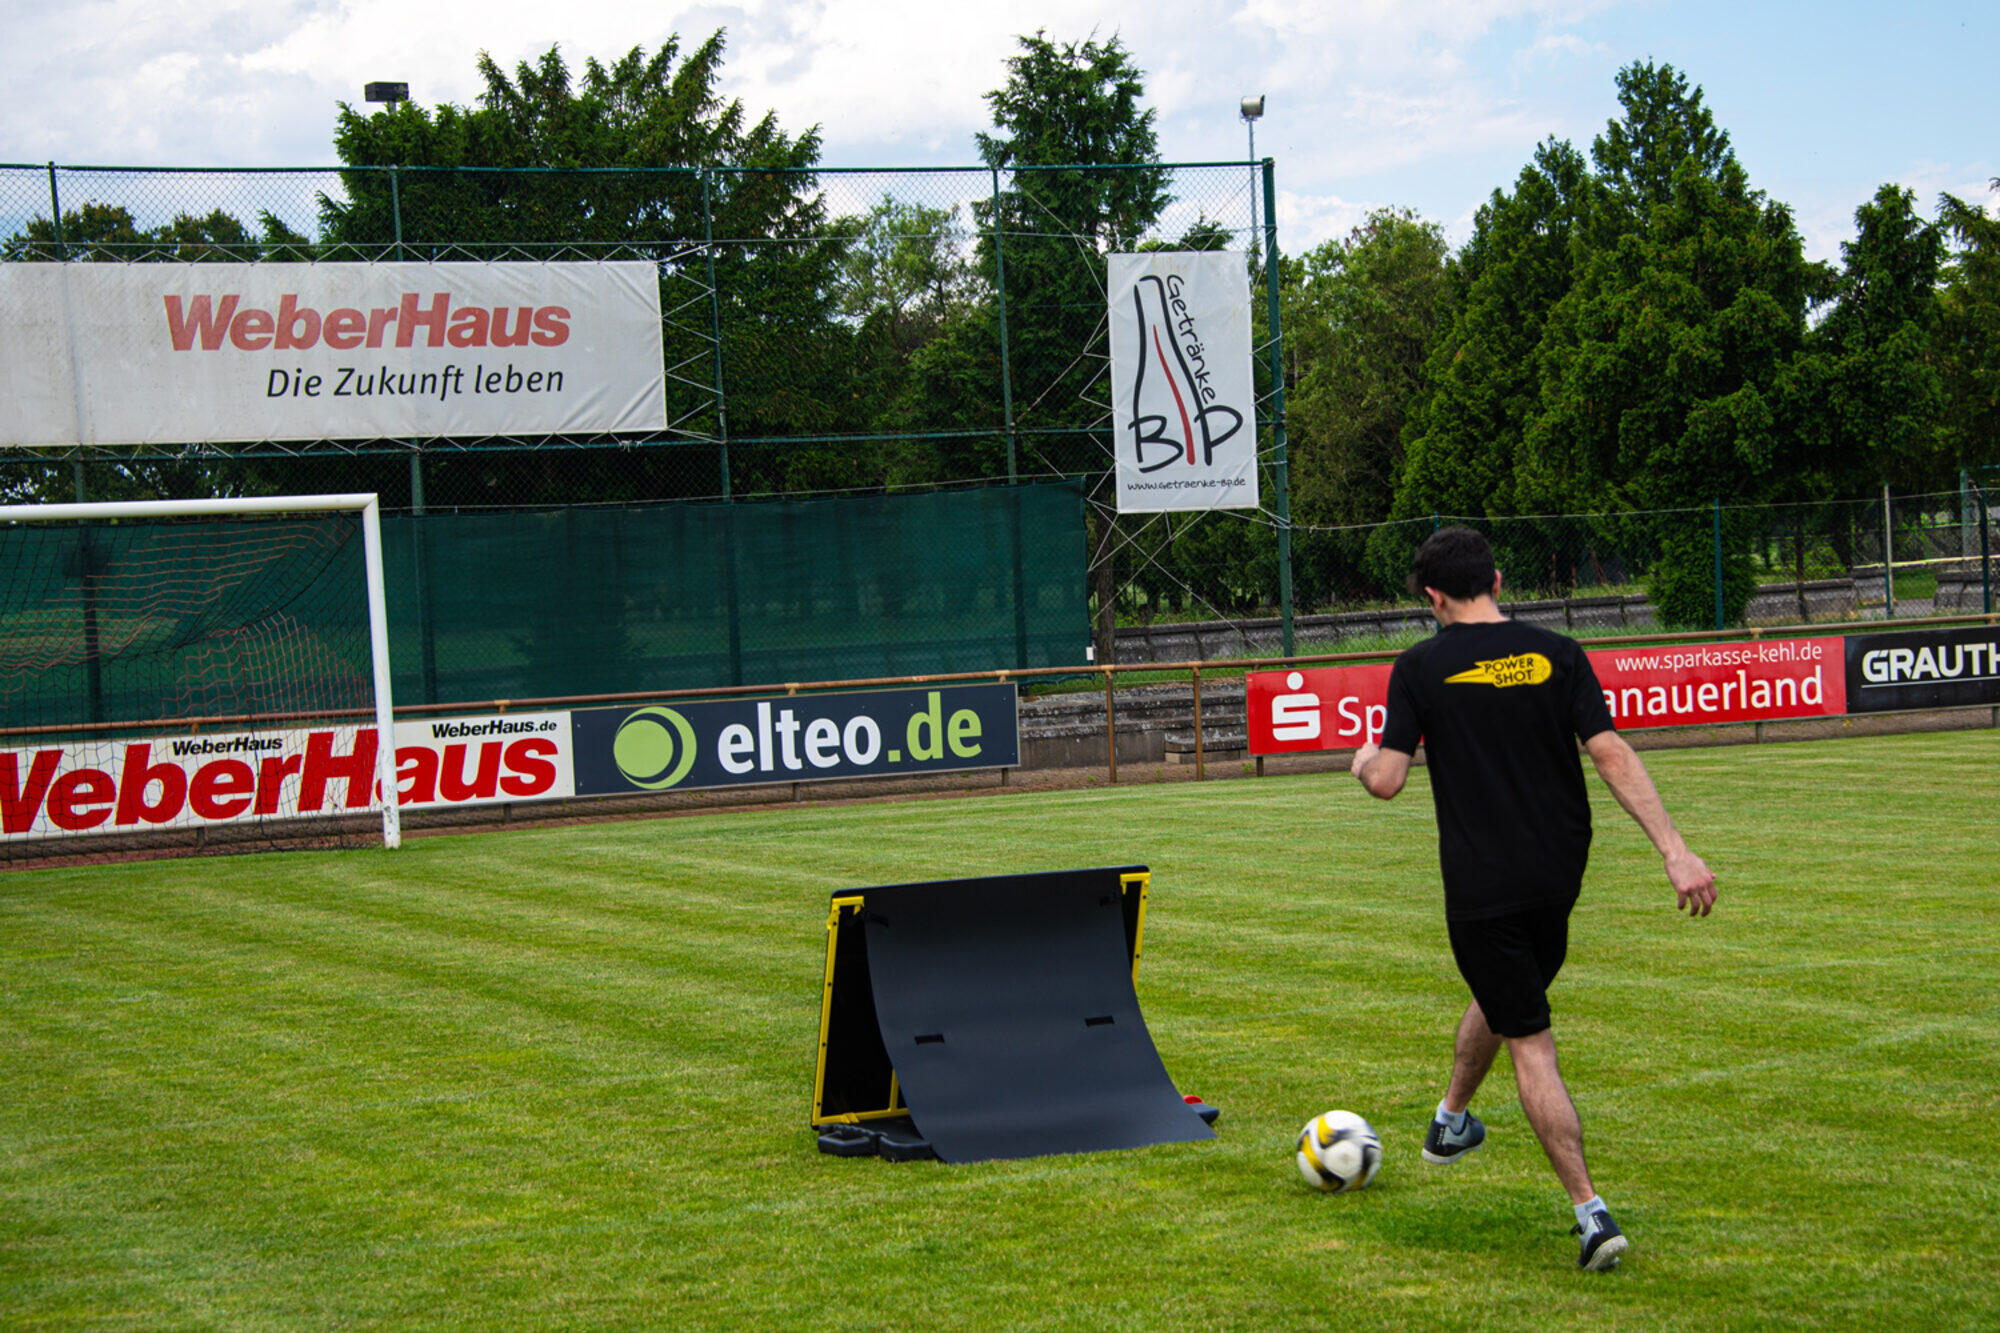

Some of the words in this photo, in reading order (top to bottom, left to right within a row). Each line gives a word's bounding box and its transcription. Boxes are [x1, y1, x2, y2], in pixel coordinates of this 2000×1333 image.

[164, 293, 571, 351] WeberHaus
[1166, 274, 1217, 405] Getränke
[267, 367, 322, 397] Die
[333, 364, 464, 402] Zukunft
[474, 364, 564, 394] leben
[1484, 657, 1534, 674] POWER
[1615, 641, 1823, 672] www.sparkasse-kehl.de
[1495, 669, 1534, 685] SHOT
[1602, 664, 1824, 718] anauerland
[431, 719, 557, 738] WeberHaus.de
[717, 690, 983, 775] elteo.de
[172, 736, 283, 756] WeberHaus
